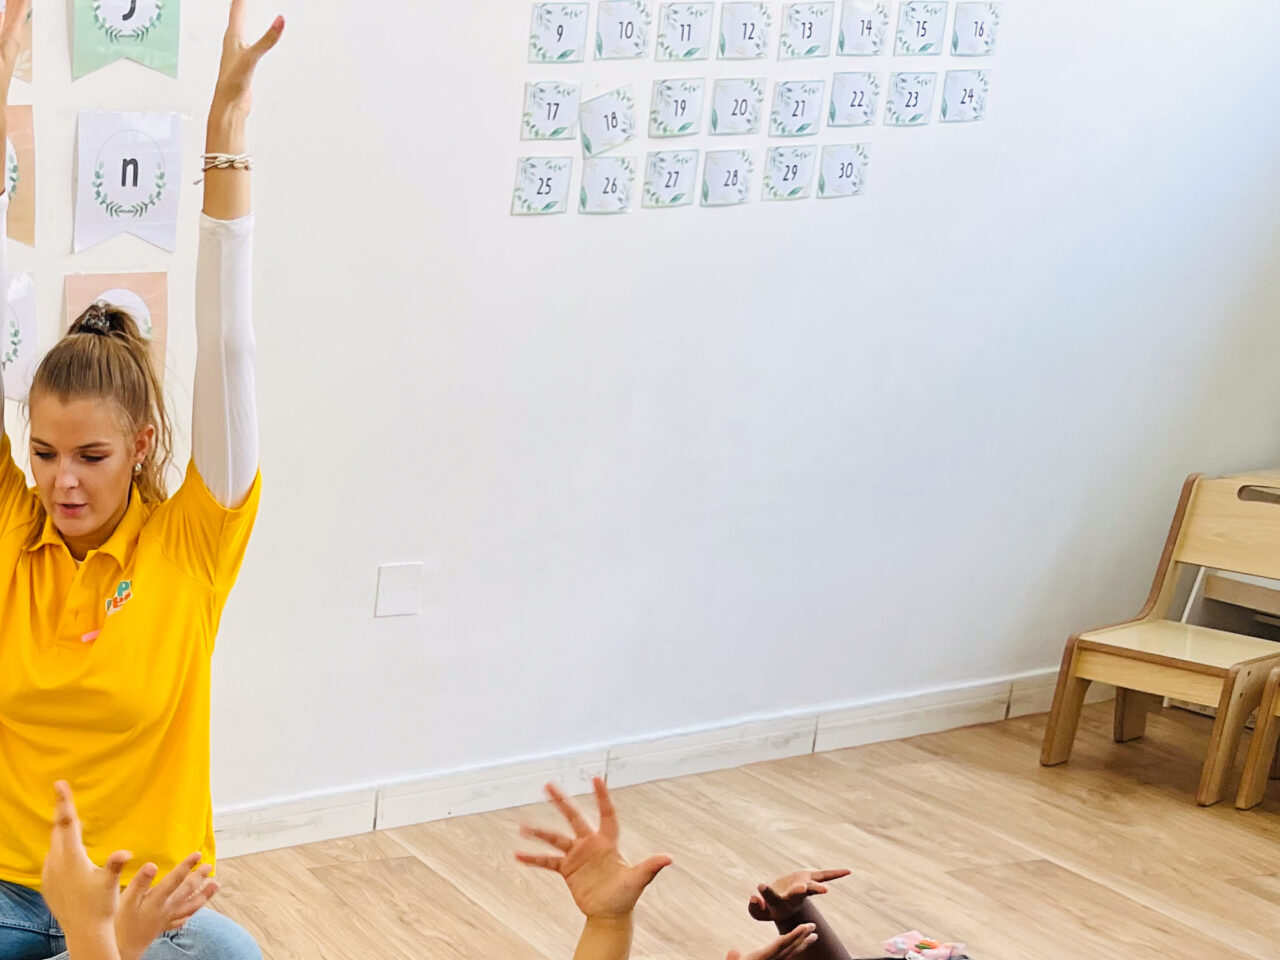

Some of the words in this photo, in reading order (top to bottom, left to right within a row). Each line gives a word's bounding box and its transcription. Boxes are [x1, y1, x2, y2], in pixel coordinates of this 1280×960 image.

[557, 25, 563, 42] 9
[619, 22, 634, 39] 10
[680, 24, 691, 41] 11
[743, 23, 755, 40] 12
[801, 22, 813, 39] 13
[860, 20, 872, 36] 14
[916, 21, 927, 37] 15
[974, 22, 984, 37] 16
[850, 91, 864, 107] 22
[905, 92, 919, 107] 23
[960, 89, 974, 104] 24
[546, 103, 559, 120] 17
[674, 100, 686, 116] 19
[732, 99, 748, 116] 20
[792, 101, 805, 117] 21
[604, 112, 618, 131] 18
[122, 158, 138, 187] n
[724, 170, 738, 186] 28
[783, 165, 798, 181] 29
[839, 163, 853, 178] 30
[537, 178, 552, 195] 25
[603, 178, 617, 194] 26
[665, 171, 679, 188] 27
